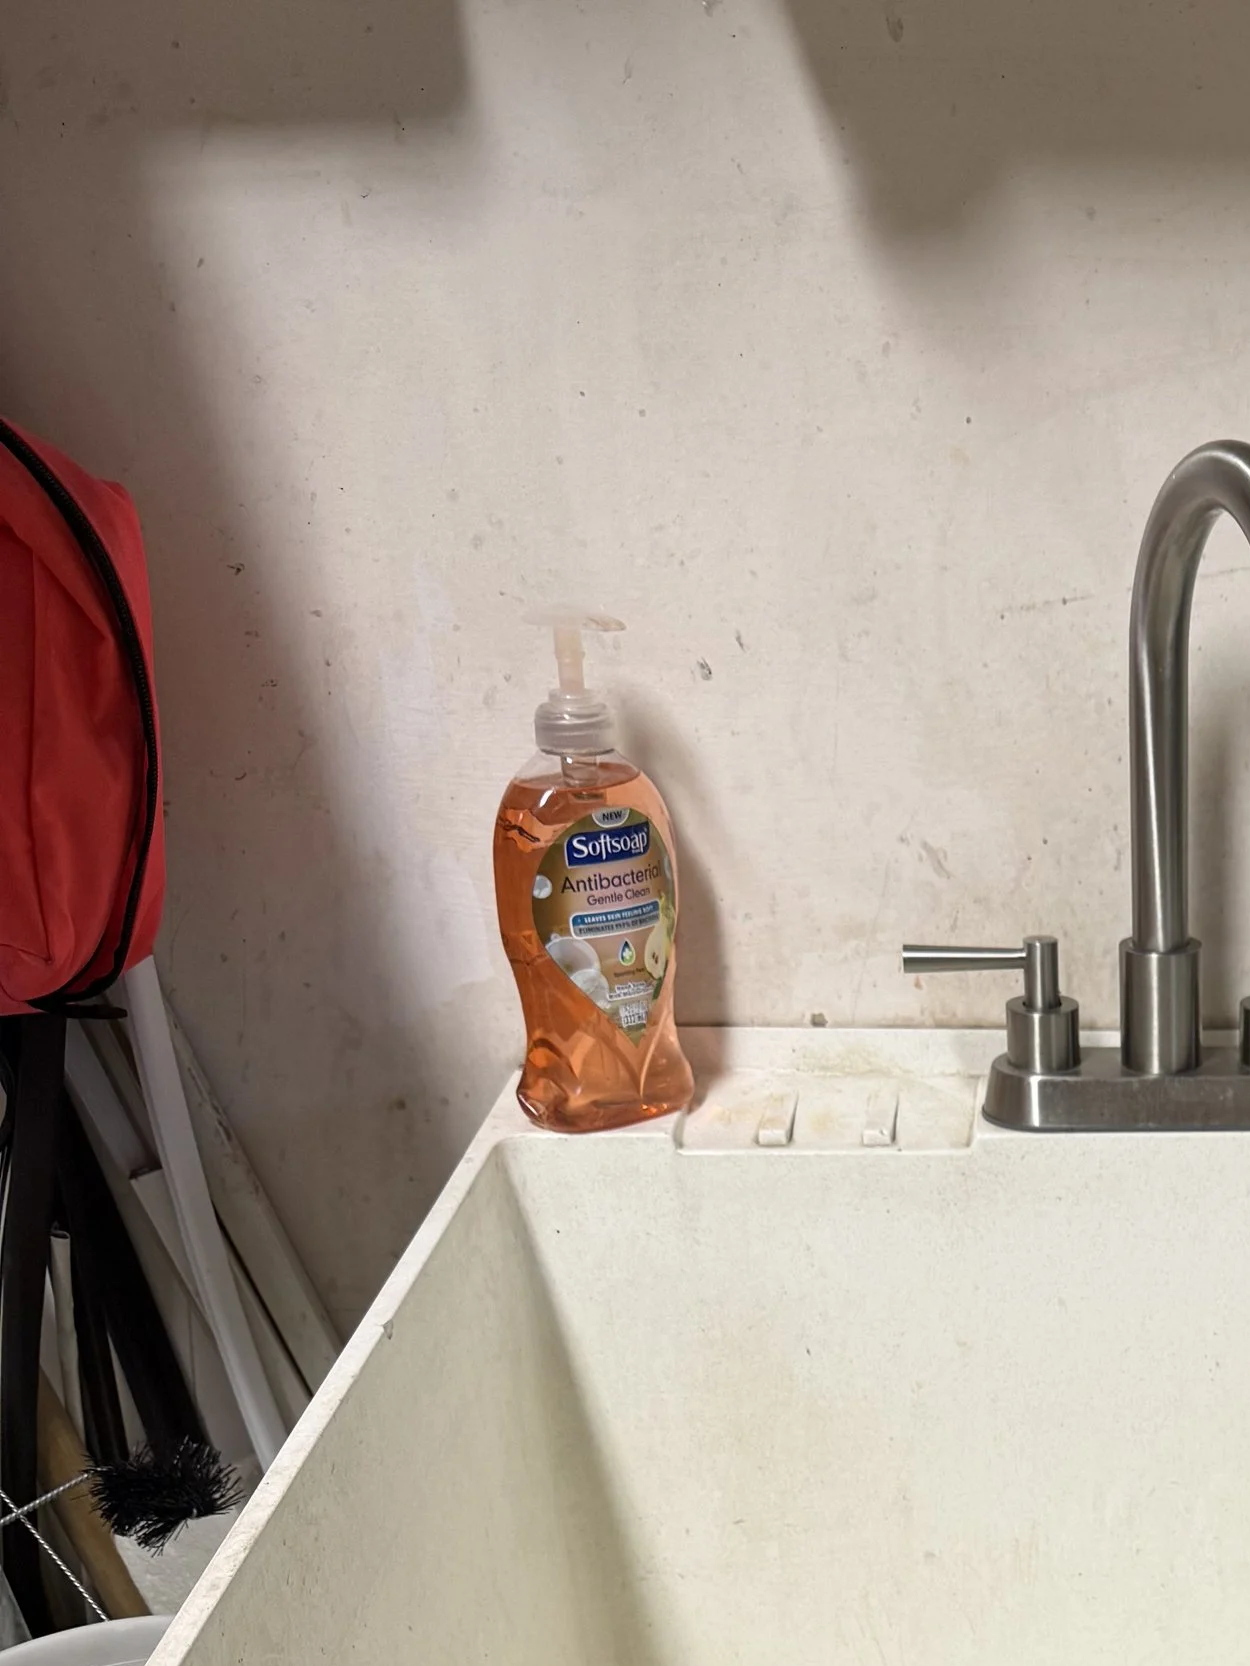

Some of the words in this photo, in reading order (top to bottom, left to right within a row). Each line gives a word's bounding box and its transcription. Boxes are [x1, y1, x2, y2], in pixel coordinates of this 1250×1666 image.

[602, 810, 623, 822] NEW
[572, 831, 647, 860] Softsoap
[561, 860, 661, 893] Antibacterial
[587, 892, 623, 906] Gentle
[625, 887, 651, 900] Clean
